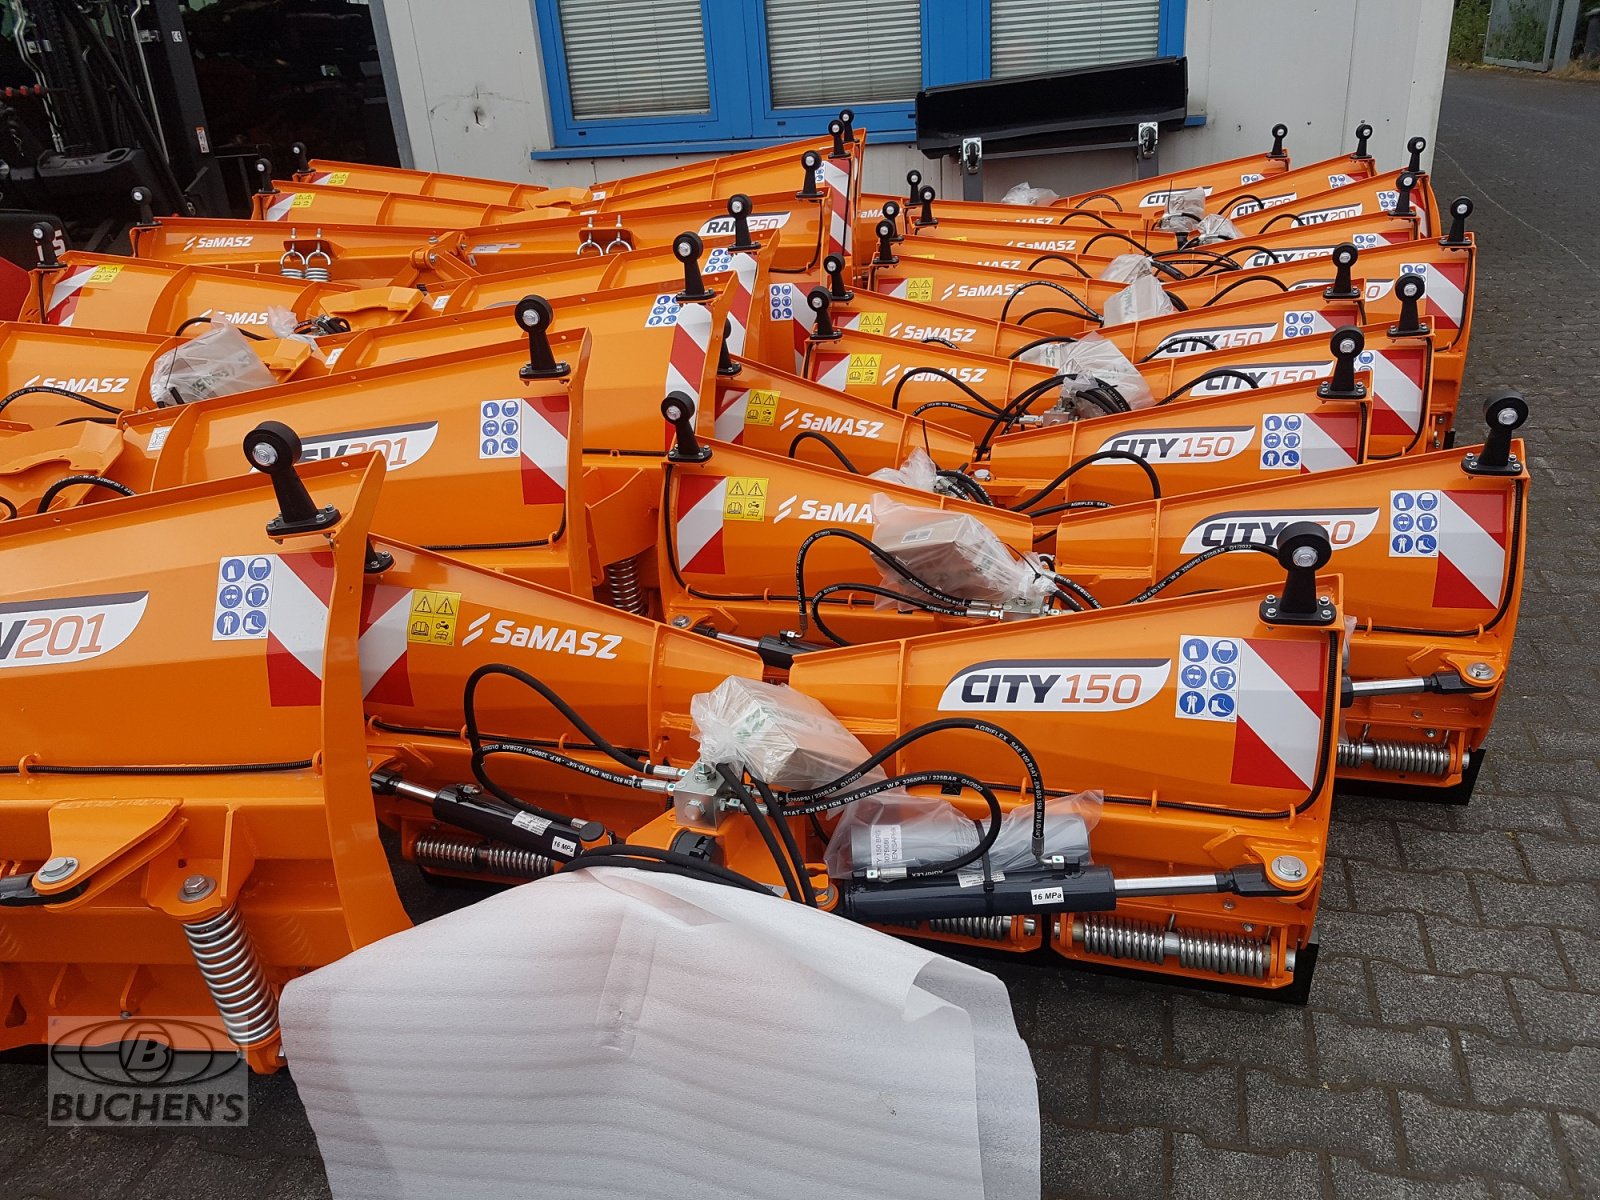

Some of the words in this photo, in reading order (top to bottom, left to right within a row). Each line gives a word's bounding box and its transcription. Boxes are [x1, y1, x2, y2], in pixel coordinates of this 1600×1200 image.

[195, 236, 254, 249] SaMASZ
[902, 325, 977, 343] SaMASZ
[797, 412, 885, 439] SaMASZ
[798, 499, 876, 525] SaMA
[490, 619, 623, 660] SaMASZ
[560, 843, 574, 853] MPa
[1033, 893, 1043, 901] 16
[1044, 892, 1062, 900] MPa
